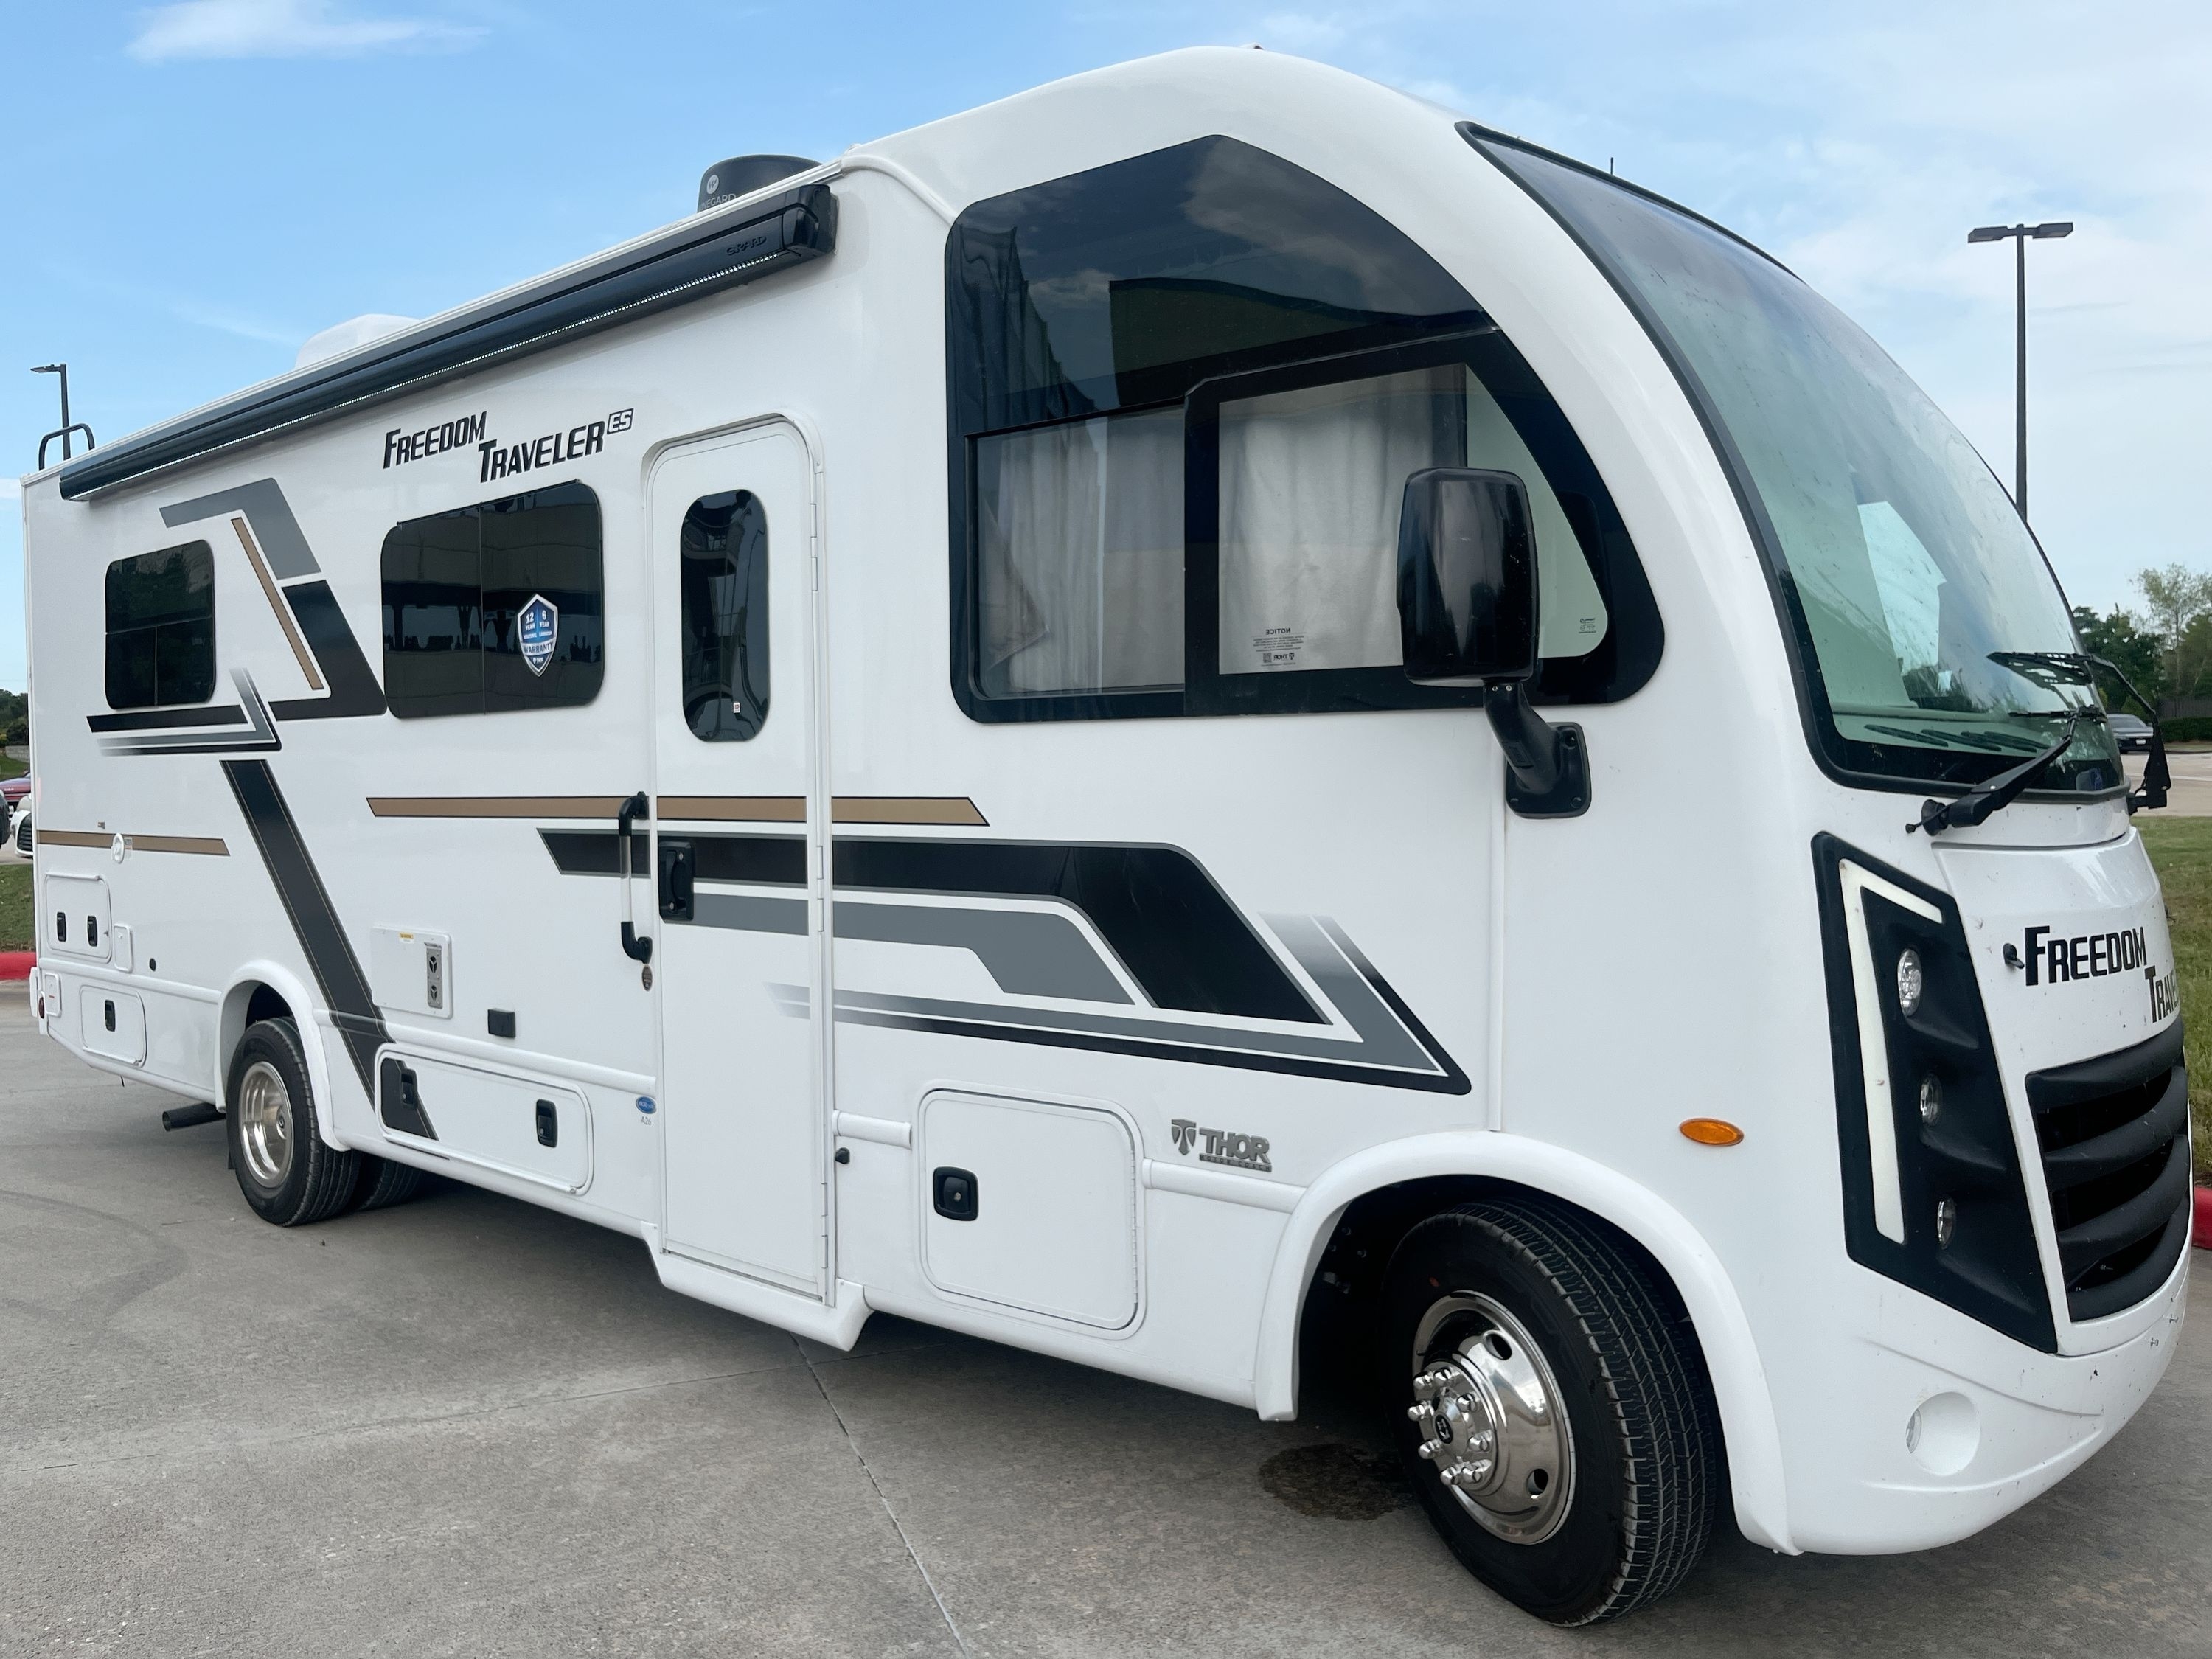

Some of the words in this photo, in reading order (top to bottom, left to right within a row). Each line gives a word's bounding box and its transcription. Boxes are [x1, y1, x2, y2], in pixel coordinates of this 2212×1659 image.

[383, 411, 487, 470] FREEDOM
[478, 420, 606, 484] TRAVELER
[608, 409, 633, 434] ES
[525, 623, 535, 631] YEAR
[526, 612, 535, 624] 12
[524, 642, 554, 653] WARRANTY
[2025, 925, 2147, 987] FREEDOM
[1199, 1127, 1271, 1164] THOR
